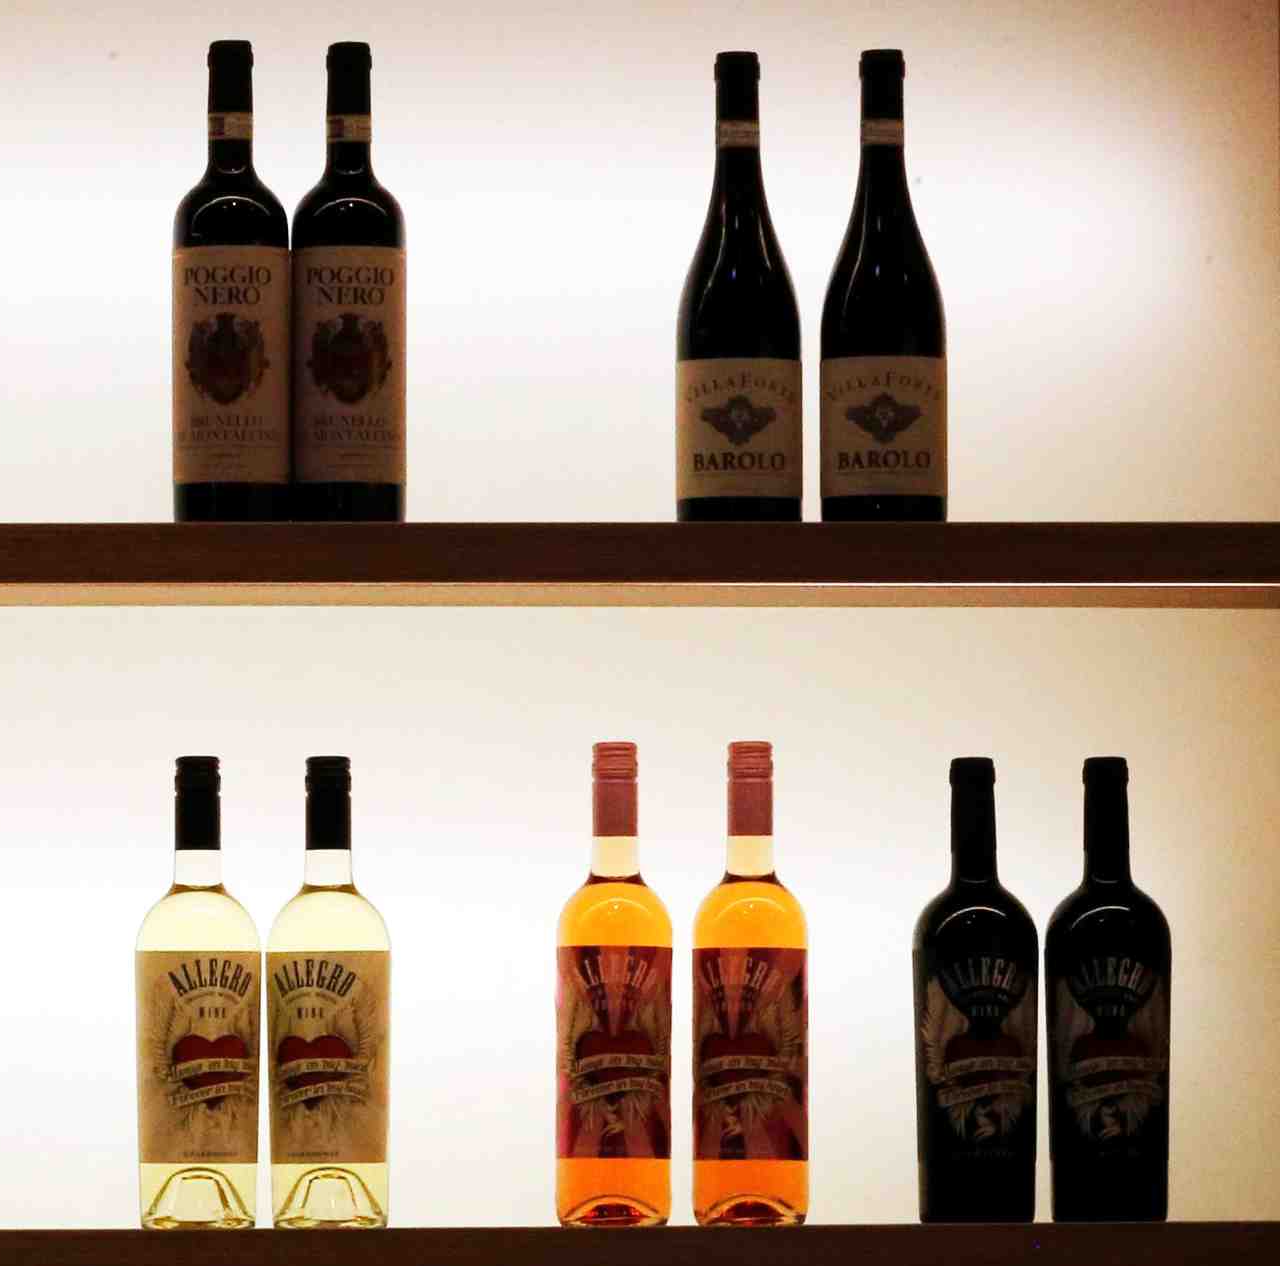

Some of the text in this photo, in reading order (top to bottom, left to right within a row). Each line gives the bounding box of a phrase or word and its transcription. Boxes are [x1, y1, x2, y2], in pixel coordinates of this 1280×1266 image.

[184, 265, 272, 287] POGGIO
[307, 265, 396, 287] POGGIO
[195, 286, 261, 305] NERO
[319, 286, 385, 305] NERO
[693, 452, 786, 473] BAROLO
[838, 450, 931, 472] BAROLO
[168, 958, 252, 997] ALLEGRO
[274, 958, 357, 998] ALLEGRO
